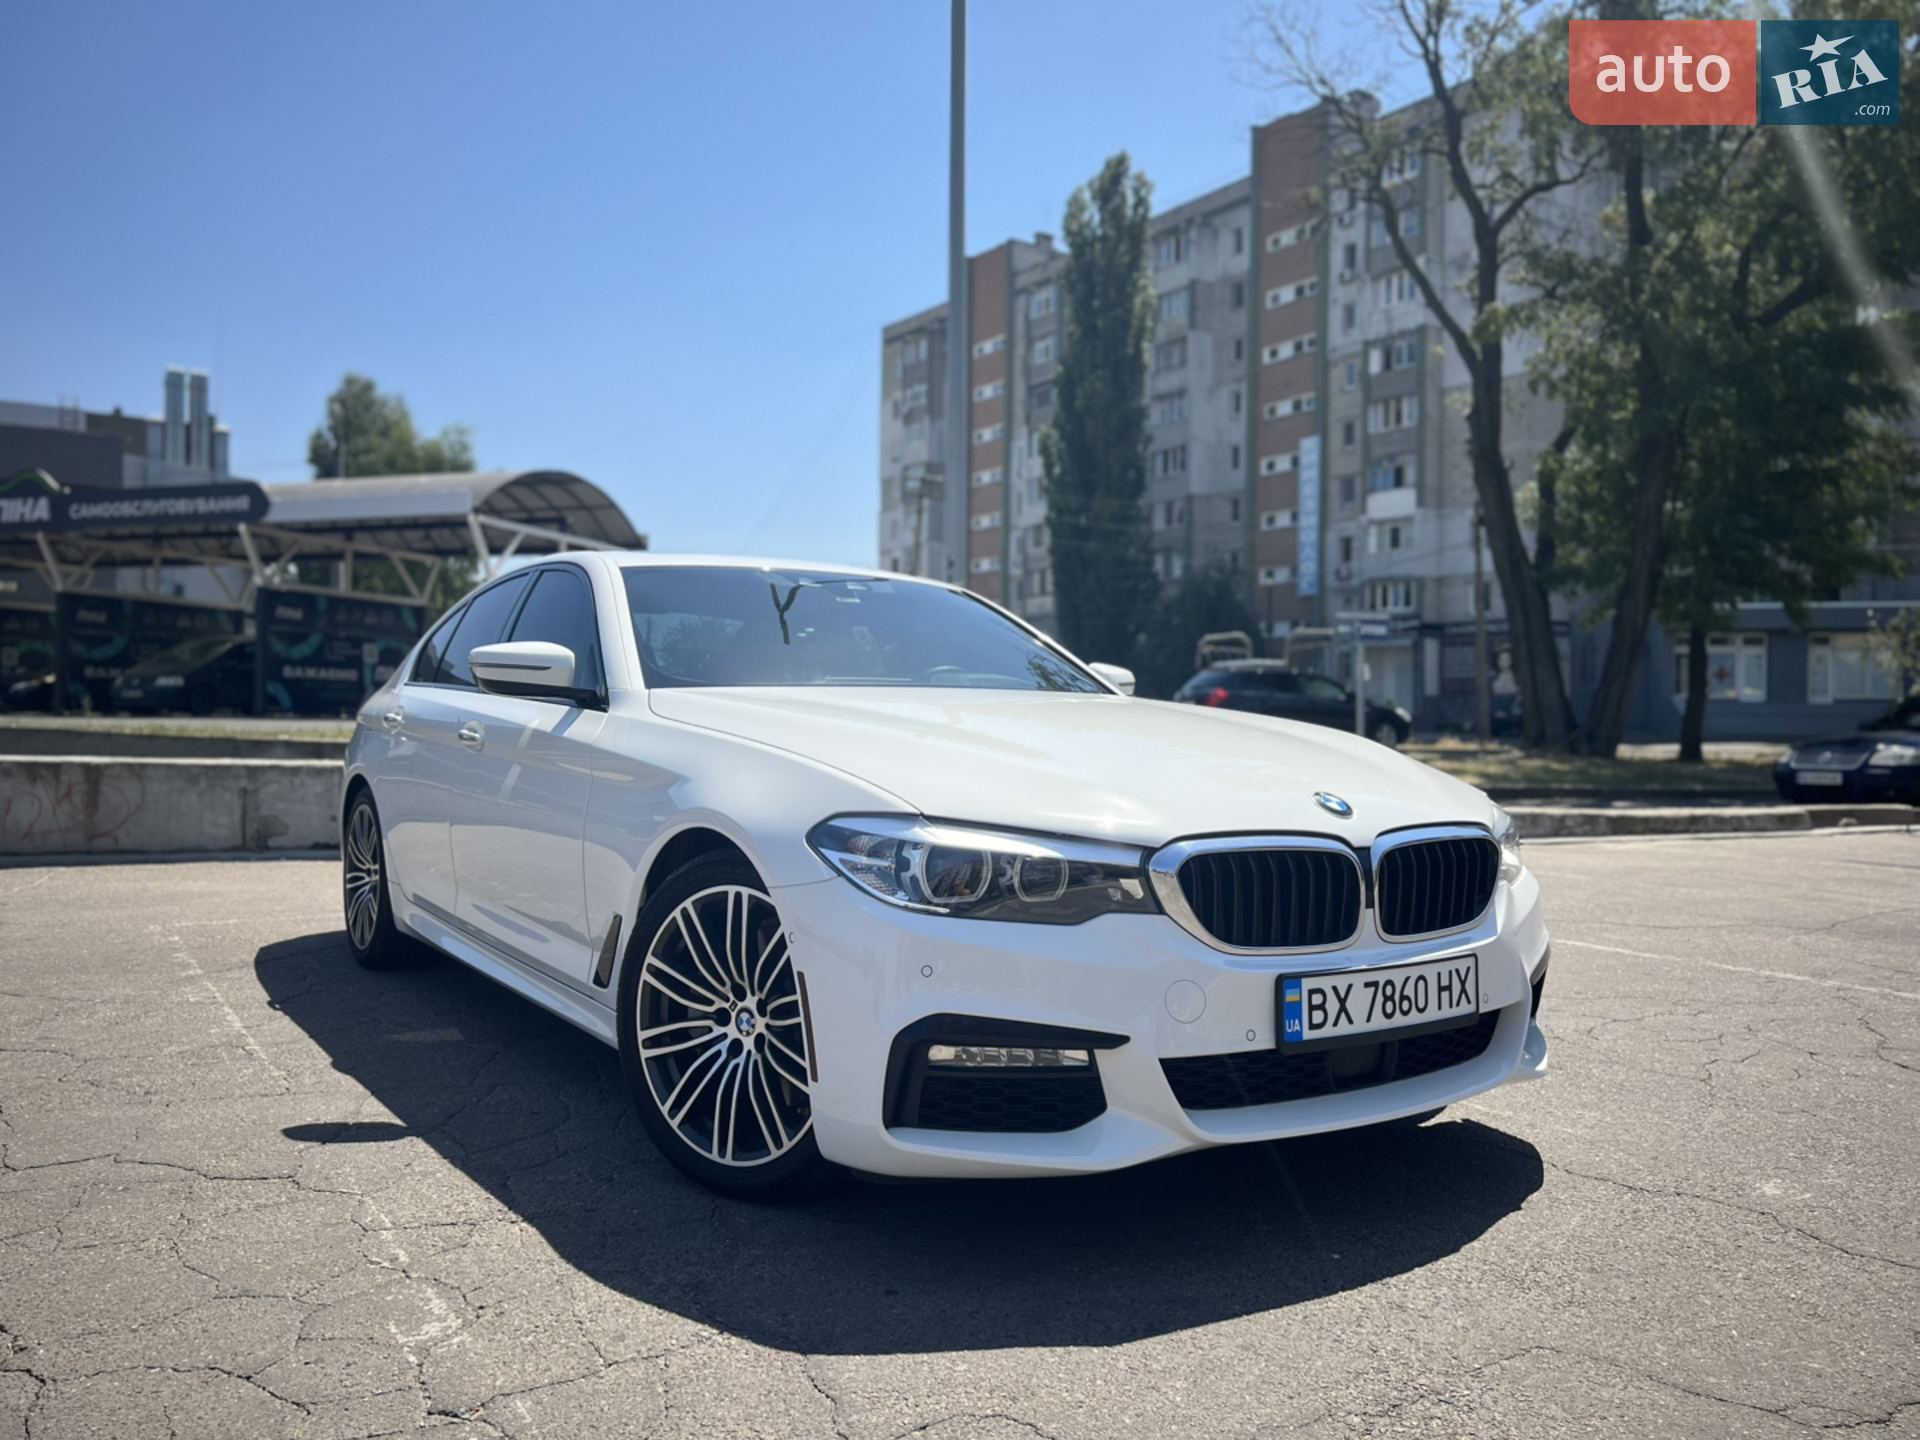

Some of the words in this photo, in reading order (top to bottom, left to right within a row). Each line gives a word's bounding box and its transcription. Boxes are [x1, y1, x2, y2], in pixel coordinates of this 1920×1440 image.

[1307, 983, 1355, 1031] BX
[1363, 974, 1428, 1023] 7860
[1437, 966, 1472, 1011] HX
[1286, 1019, 1301, 1033] UA
